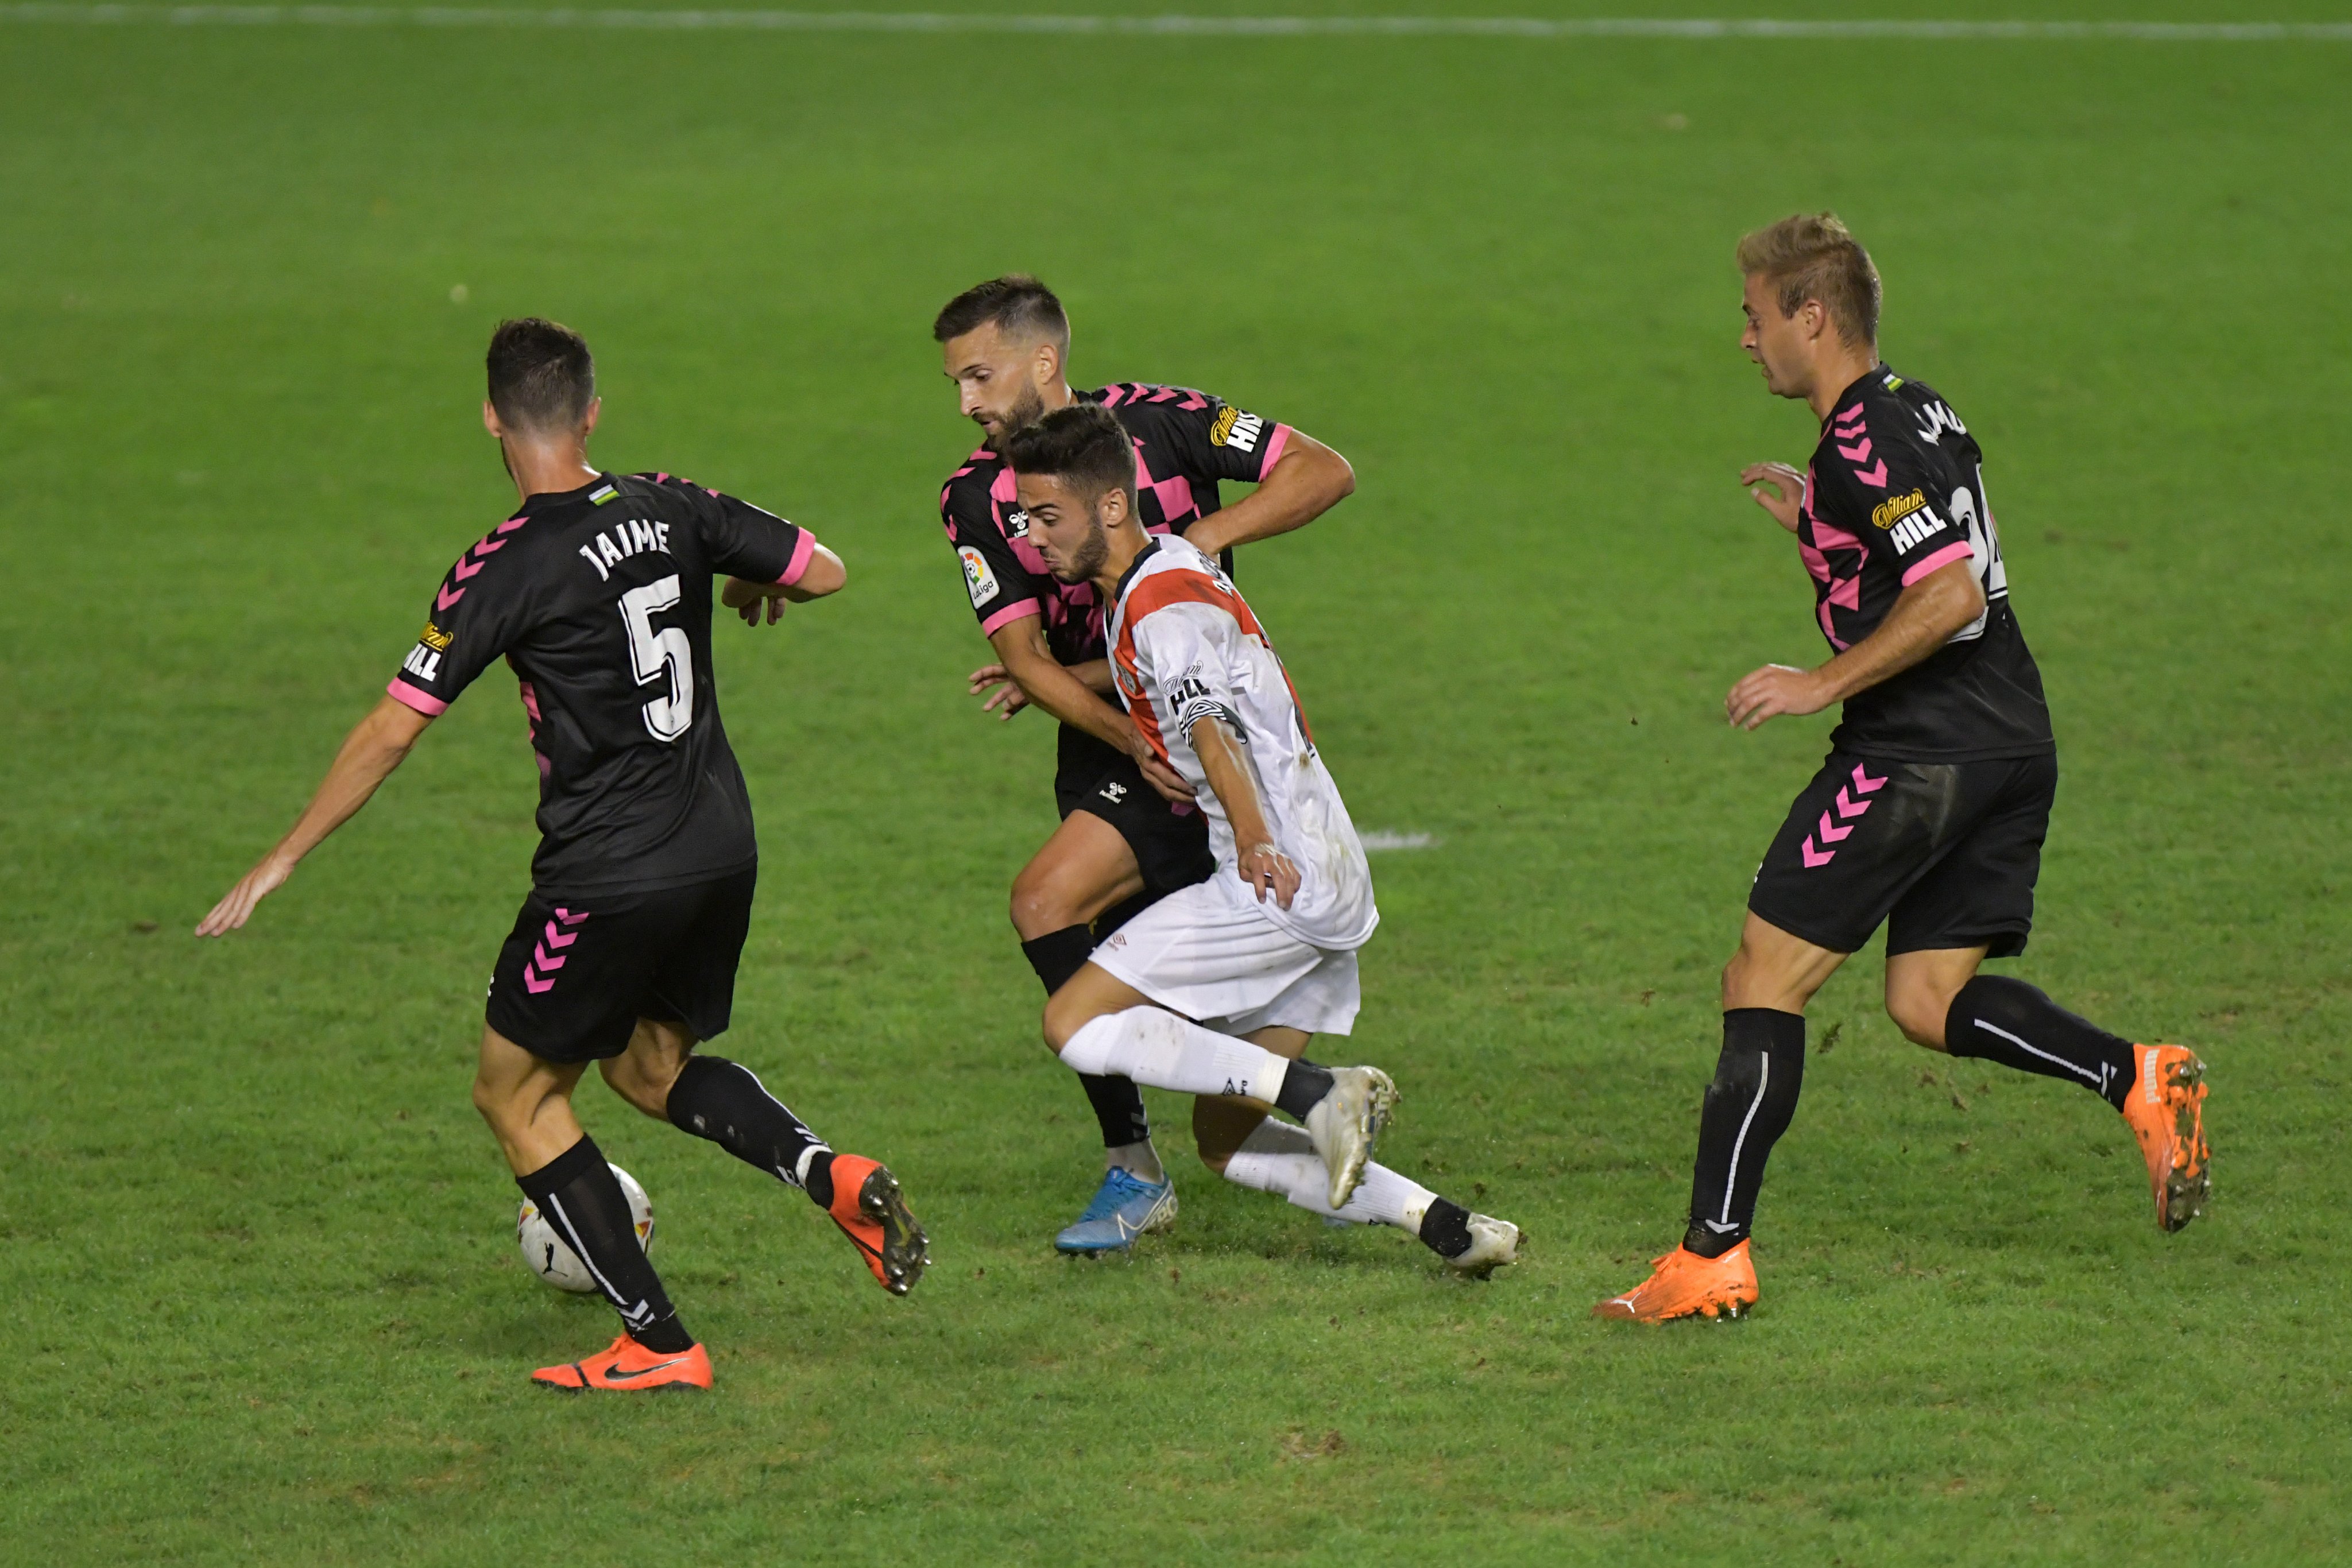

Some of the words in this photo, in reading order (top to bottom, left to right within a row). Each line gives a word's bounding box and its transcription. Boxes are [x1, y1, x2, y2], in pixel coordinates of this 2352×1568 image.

[1872, 487, 1927, 529] William
[1889, 505, 1947, 556] HILL
[579, 518, 671, 582] JAIME
[973, 580, 994, 600] LaLiga
[403, 642, 442, 682] ILL
[617, 573, 694, 742] 5
